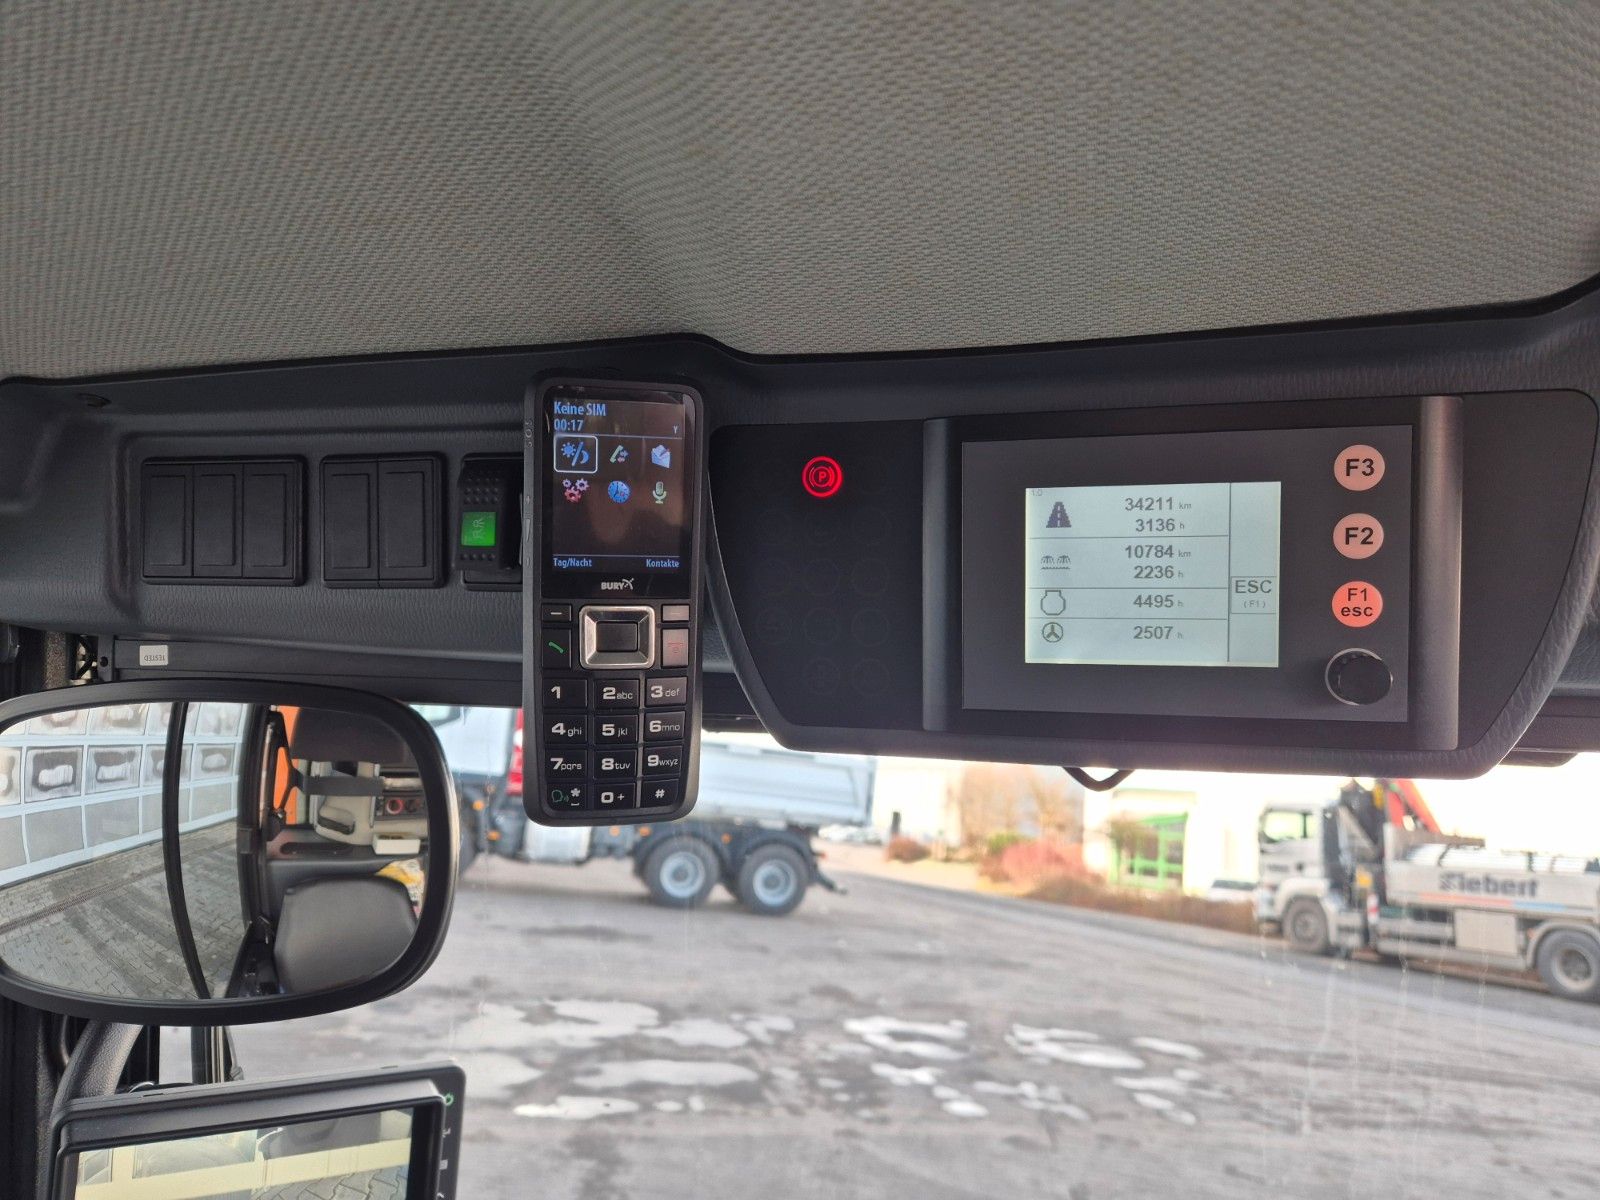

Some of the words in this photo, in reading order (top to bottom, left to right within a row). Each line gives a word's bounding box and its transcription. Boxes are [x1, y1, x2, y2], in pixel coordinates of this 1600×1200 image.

[553, 401, 584, 416] Keine
[586, 403, 607, 417] SIM
[553, 418, 584, 432] 00:17
[1345, 458, 1375, 477] F3
[1124, 497, 1174, 512] 34211
[1179, 501, 1192, 510] km
[1135, 518, 1175, 532] 3136
[1179, 522, 1185, 530] h
[1344, 527, 1374, 546] F2
[1124, 545, 1174, 559] 10784
[1178, 549, 1191, 558] km
[553, 557, 593, 568] Tag/Nacht
[646, 558, 680, 569] Kontakte
[1133, 565, 1174, 579] 2236
[1178, 570, 1184, 578] h
[601, 581, 625, 590] BURY
[1234, 579, 1272, 594] ESC
[1133, 594, 1174, 608] 4495
[1347, 588, 1368, 602] F1
[1340, 606, 1374, 617] esc
[1133, 626, 1174, 640] 2507
[144, 654, 165, 662] TESTED
[551, 686, 561, 699] 1
